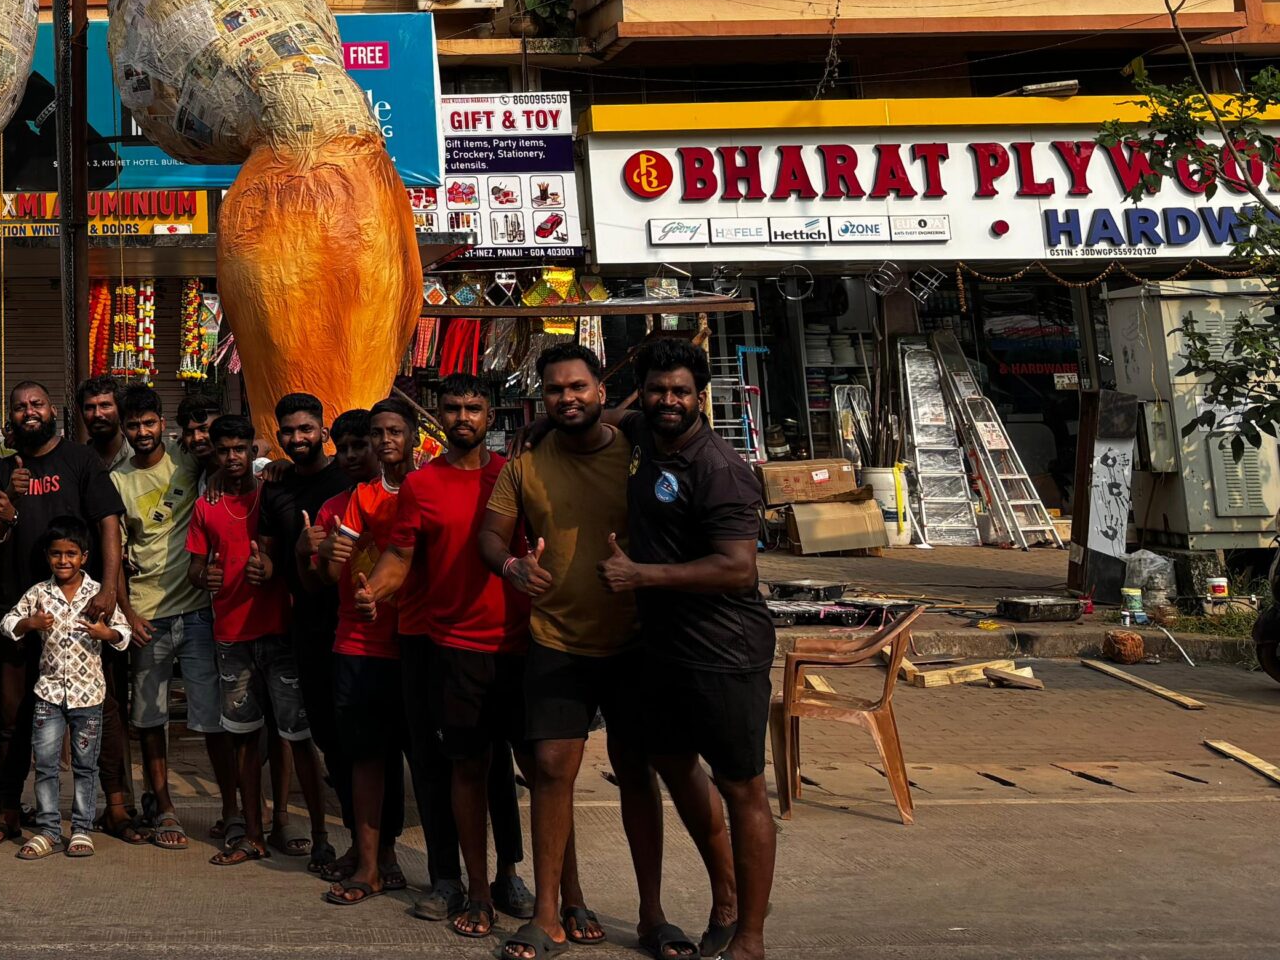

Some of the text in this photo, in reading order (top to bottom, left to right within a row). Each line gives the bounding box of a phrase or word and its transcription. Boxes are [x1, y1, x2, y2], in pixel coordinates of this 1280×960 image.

[349, 46, 384, 65] FREE
[513, 94, 568, 105] 8600965509
[450, 109, 561, 131] GIFT & TOY
[445, 138, 547, 149] Gift items, Party items,
[453, 150, 495, 160] Crockery,
[497, 149, 546, 159] Stationery,
[133, 158, 159, 166] HOTEL
[451, 161, 489, 169] utensils.
[677, 141, 950, 201] BHARAT
[969, 139, 1280, 196] PLYWOO
[89, 224, 98, 234] &
[102, 224, 139, 234] DOORS
[658, 221, 702, 241] Godrej
[773, 229, 826, 240] Hettich
[497, 249, 523, 257] PANAJI
[530, 248, 545, 256] GOA
[546, 248, 575, 256] 403001
[1049, 248, 1074, 257] GSTIN
